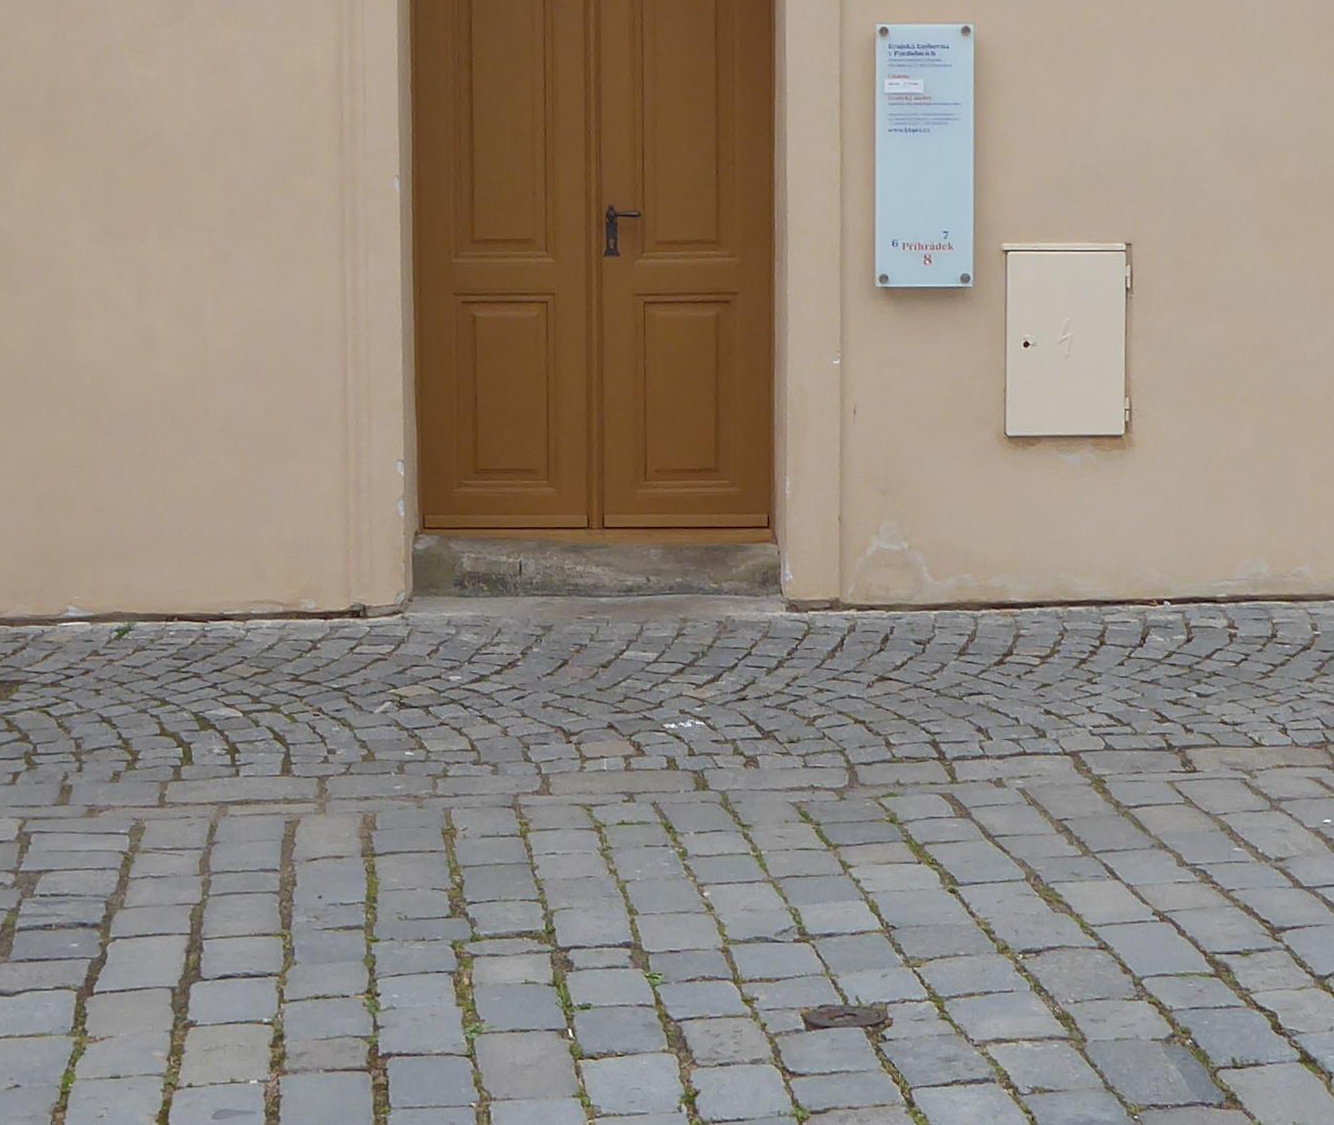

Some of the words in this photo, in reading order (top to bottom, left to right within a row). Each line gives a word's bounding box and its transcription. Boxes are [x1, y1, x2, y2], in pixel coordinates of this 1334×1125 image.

[943, 230, 949, 239] 7
[891, 239, 899, 248] 6
[923, 254, 932, 266] 8
